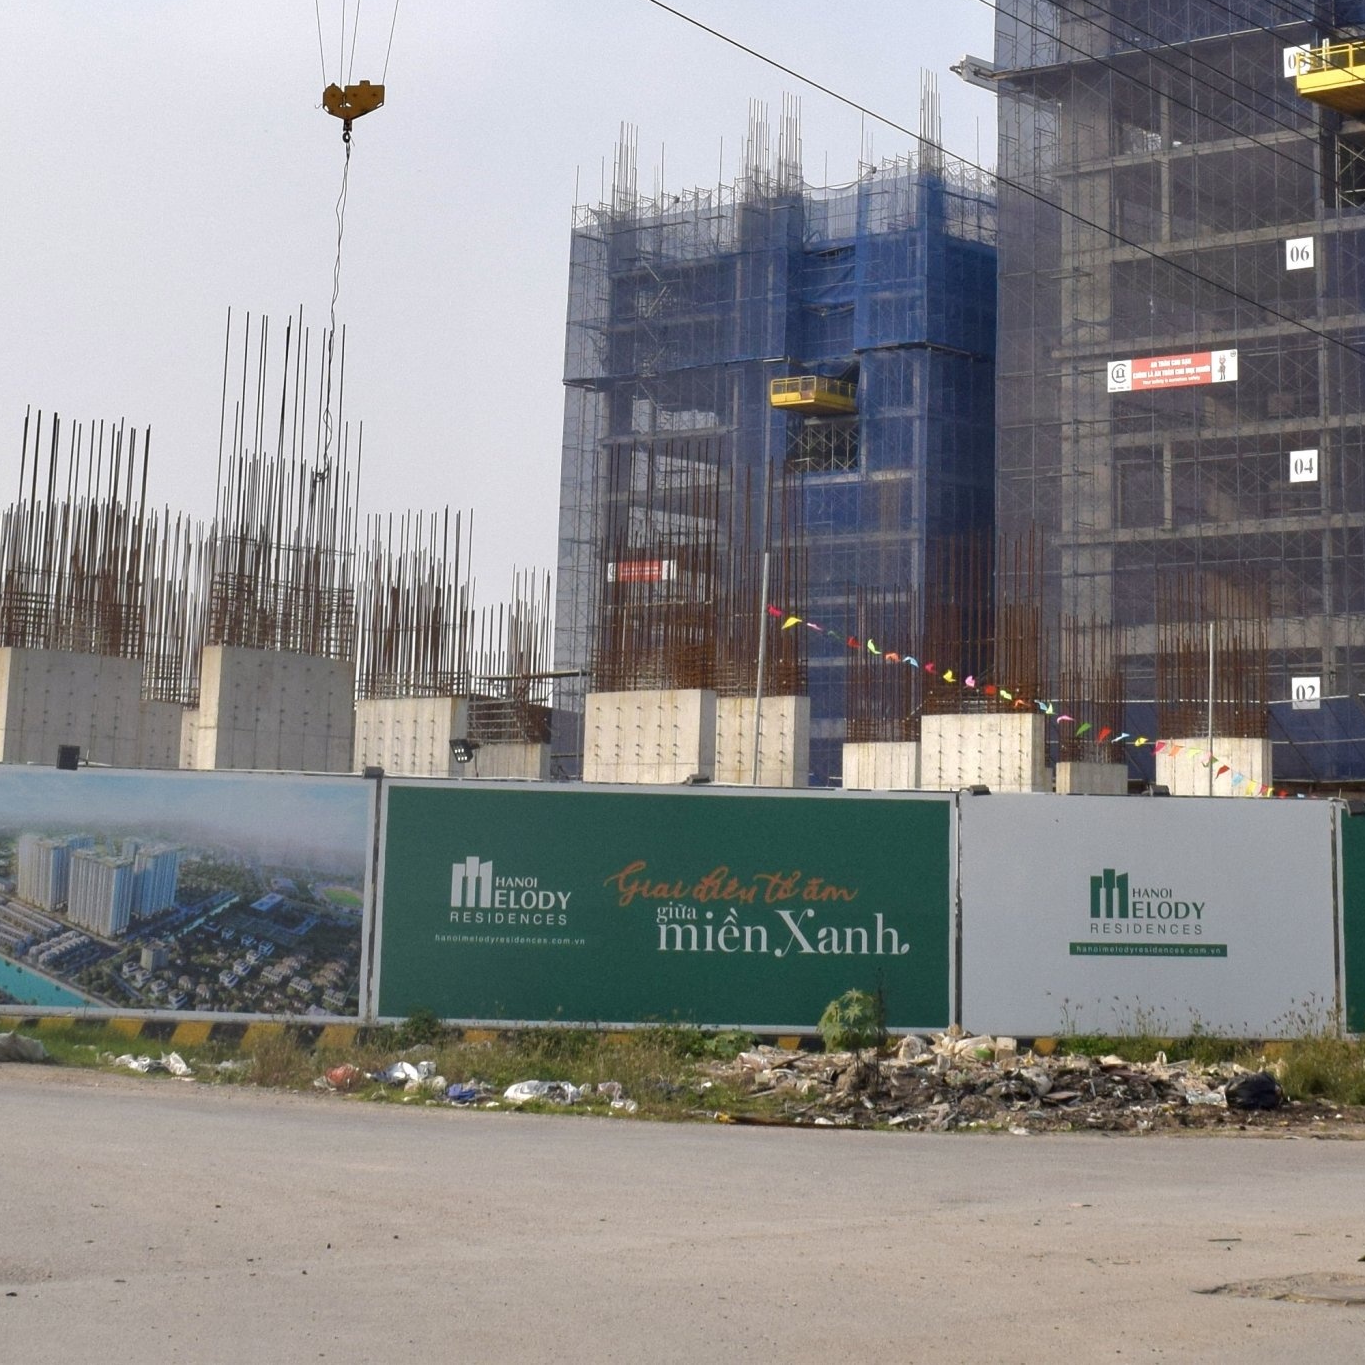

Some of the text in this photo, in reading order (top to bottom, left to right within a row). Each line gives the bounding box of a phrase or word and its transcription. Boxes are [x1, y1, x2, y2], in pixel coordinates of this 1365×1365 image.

[1290, 245, 1310, 262] 06
[1295, 457, 1313, 475] 04
[1296, 685, 1315, 702] 02
[495, 876, 538, 888] HANOI
[1132, 888, 1173, 899] HANOI
[450, 911, 567, 926] RESIDENCES
[656, 901, 698, 924] giữa
[656, 907, 910, 958] miền Xanh
[1090, 923, 1202, 935] RESIDENCES
[435, 934, 586, 946] hanoimelodyresidences.com.vn
[1076, 945, 1221, 956] hanoimelodyresidences.com.vn
